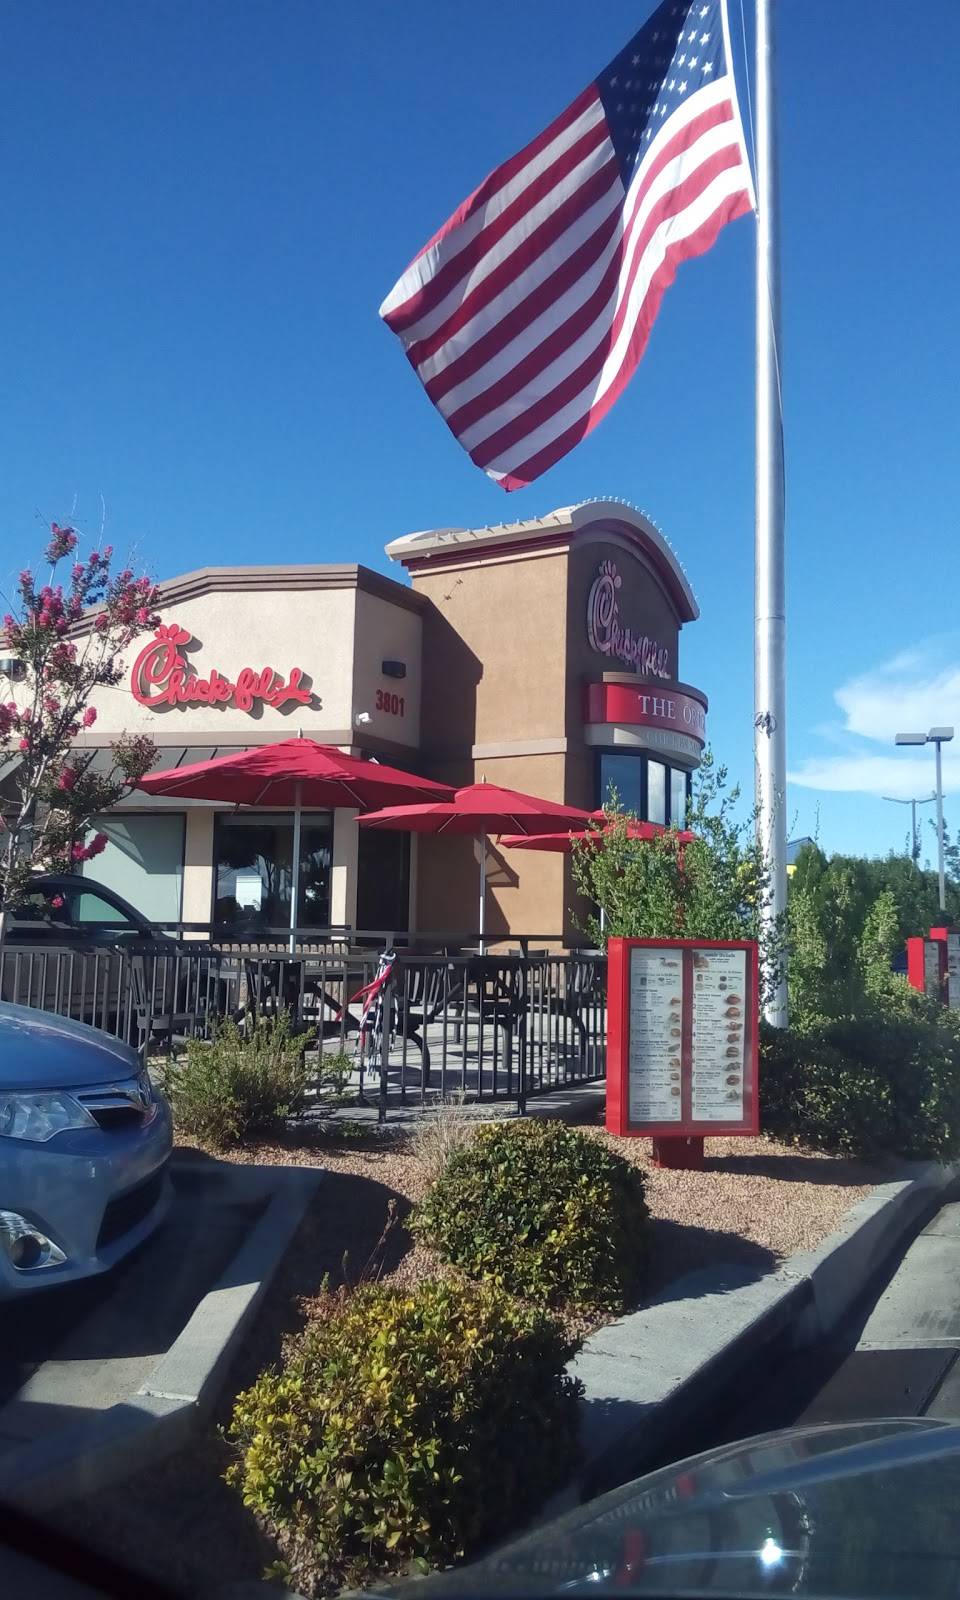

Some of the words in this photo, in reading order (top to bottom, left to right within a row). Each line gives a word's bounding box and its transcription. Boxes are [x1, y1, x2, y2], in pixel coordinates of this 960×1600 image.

[131, 623, 312, 711] Chick-fil-A
[376, 688, 405, 718] 3801
[638, 695, 675, 720] THE
